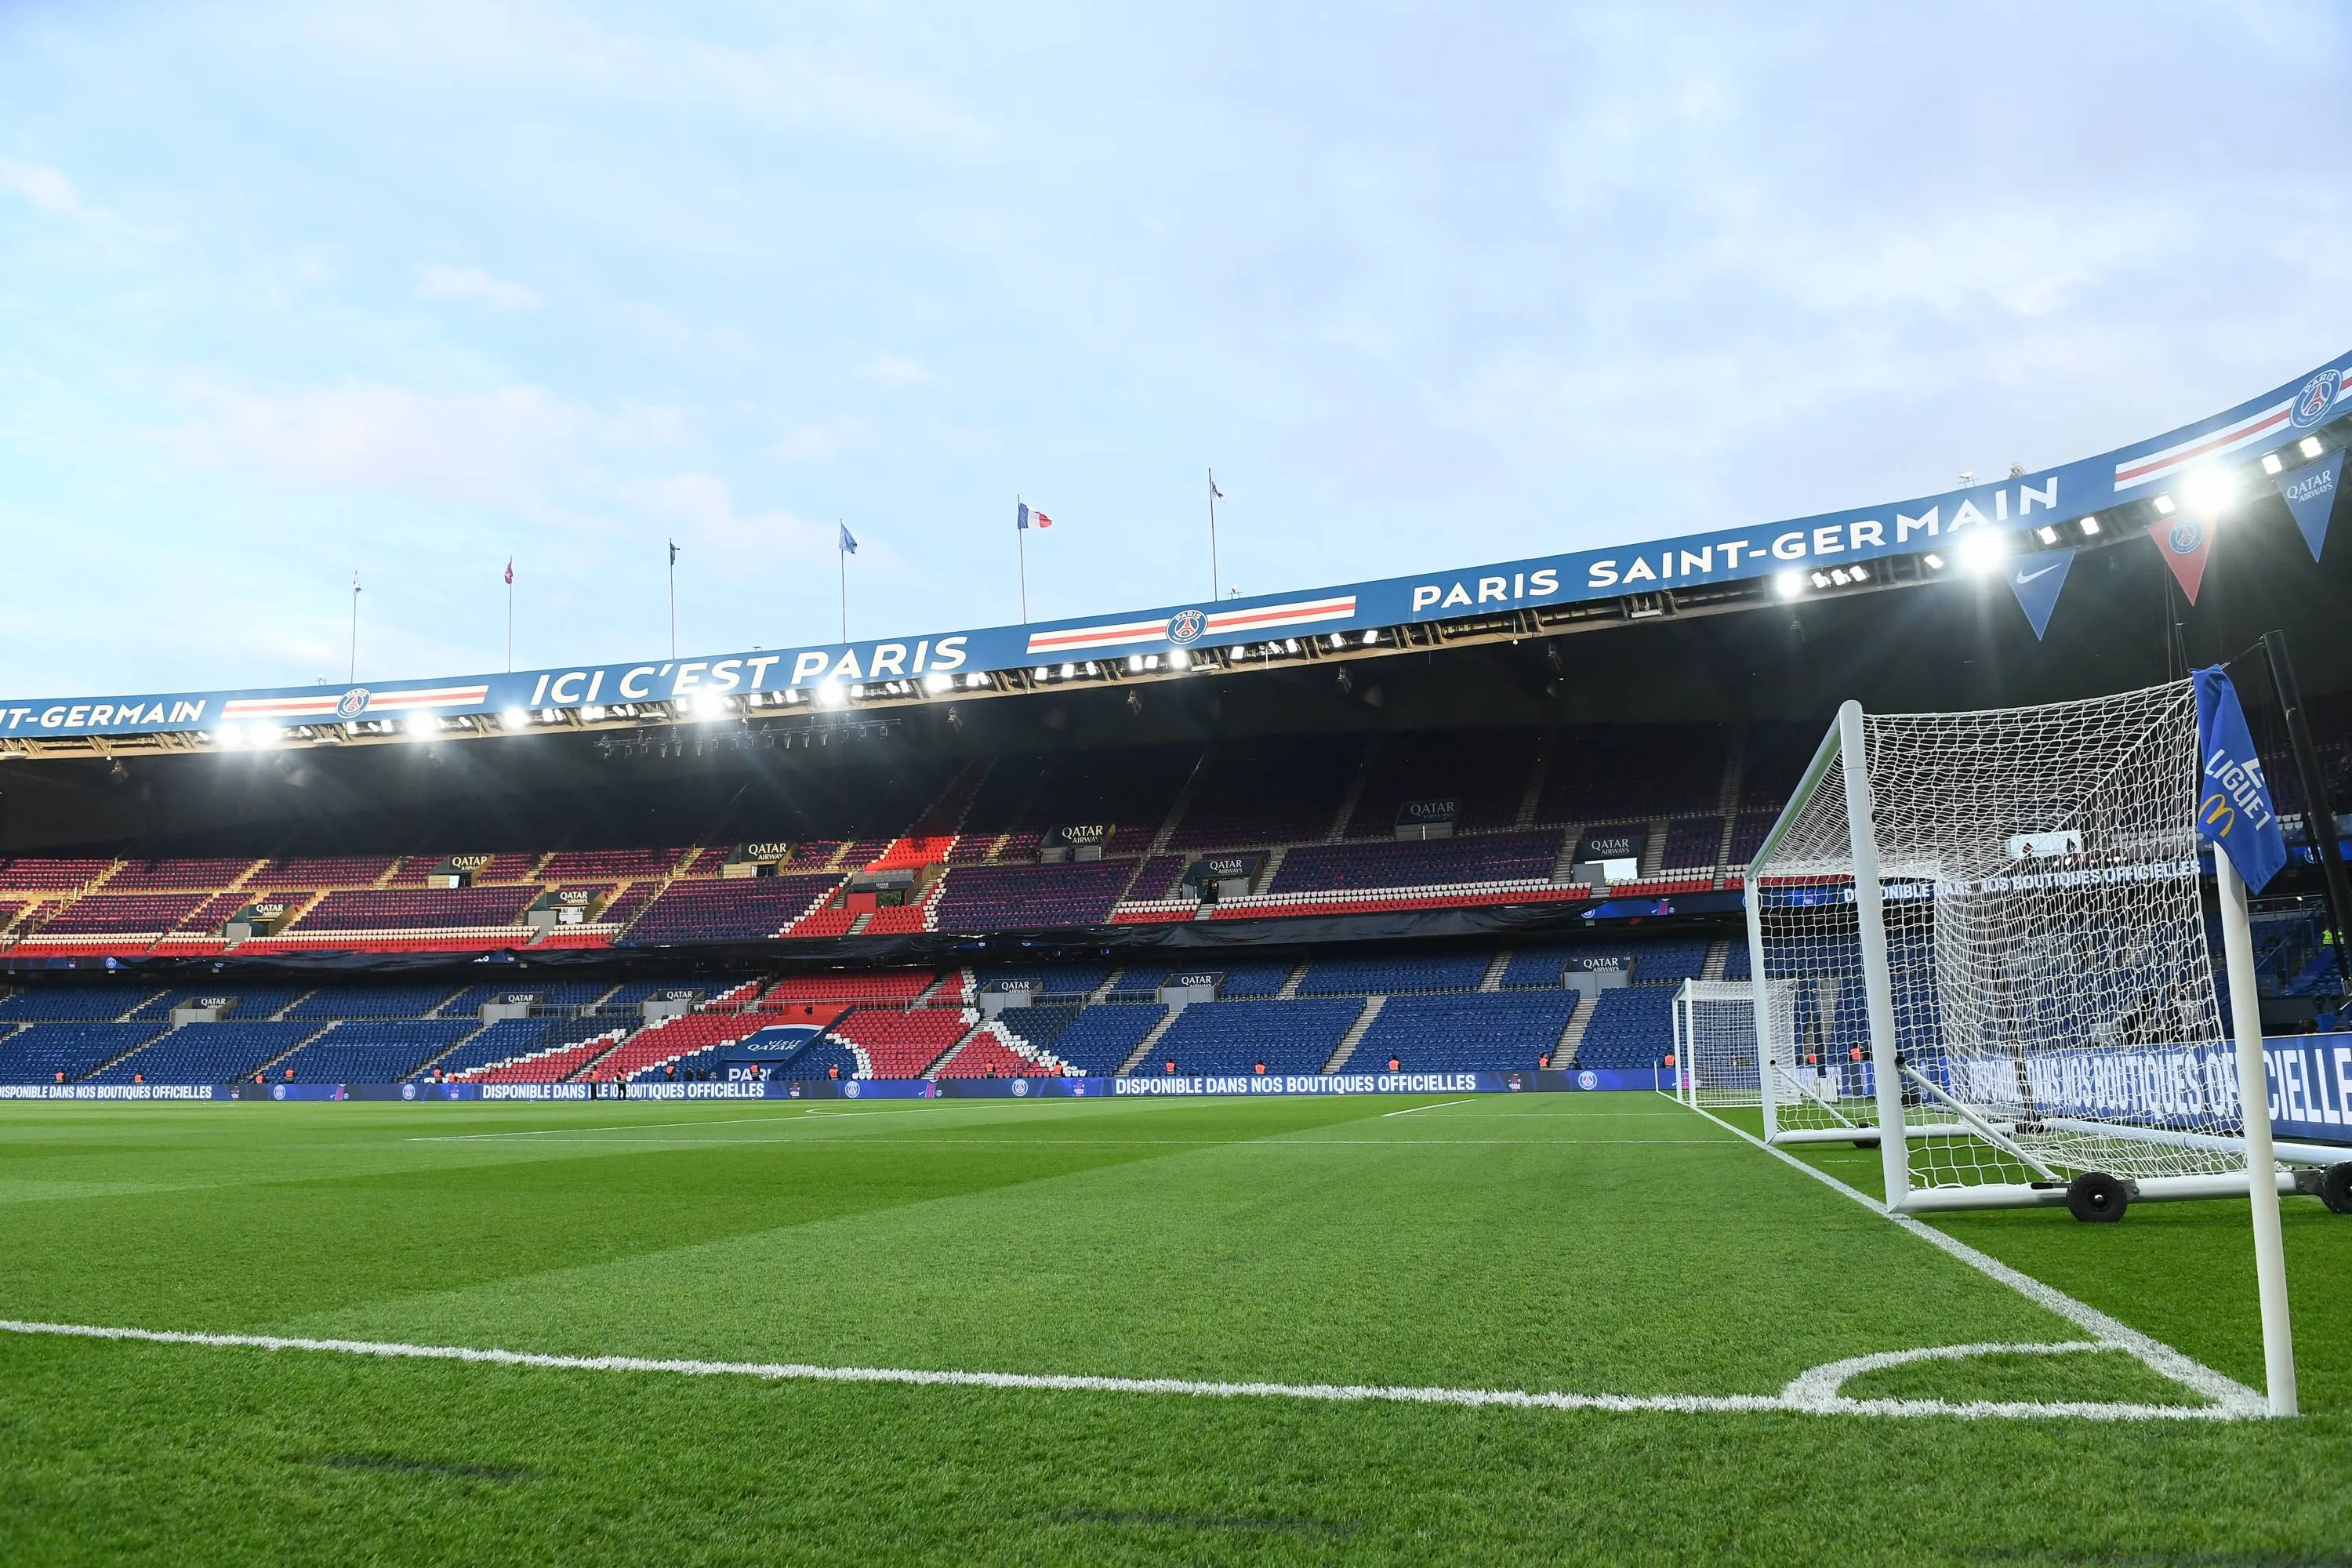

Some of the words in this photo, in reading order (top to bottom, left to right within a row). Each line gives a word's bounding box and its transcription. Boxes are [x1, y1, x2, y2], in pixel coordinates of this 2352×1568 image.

[2287, 470, 2332, 499] QATAR
[2299, 481, 2333, 503] AIRWAYS
[1412, 568, 1559, 612] PARIS
[1588, 477, 2058, 590] SAINT-GERMAIN
[1175, 612, 1202, 622] PARIS
[530, 673, 604, 706] ICI
[619, 659, 780, 700] C'EST
[791, 636, 969, 685] PARIS
[2205, 749, 2264, 820] LIGUE
[1410, 801, 1454, 816] QATAR
[1062, 825, 1103, 840] QATAR
[748, 843, 787, 856] QATAR
[1591, 838, 1629, 851] QATAR
[1210, 859, 1243, 871] QATAR
[2013, 869, 2100, 891] BOUTIQUES
[560, 891, 588, 901] QATAR
[256, 904, 284, 913] QATAR
[1583, 957, 1619, 969] QATAR
[1001, 981, 1029, 991] QATAR
[1181, 975, 1212, 986] QATAR
[508, 994, 534, 1004] QATAR
[666, 990, 693, 1000] QATAR
[201, 997, 227, 1007] QATAR
[482, 1084, 550, 1099] DISPONIBLE
[554, 1084, 586, 1098] DANS
[626, 1083, 685, 1099] BOUTIQUES
[688, 1082, 764, 1098] OFFICIELLES
[1116, 1077, 1203, 1095] DISPONIBLE
[1206, 1076, 1247, 1094] DANS
[1251, 1076, 1283, 1094] NOS
[1287, 1075, 1374, 1094] BOUTIQUES
[1377, 1074, 1475, 1092] OFFICIELLES
[49, 1086, 74, 1098] DANS
[76, 1086, 96, 1098] NOS
[98, 1086, 151, 1099] BOUTIQUES
[152, 1086, 212, 1099] OFFICIELLES
